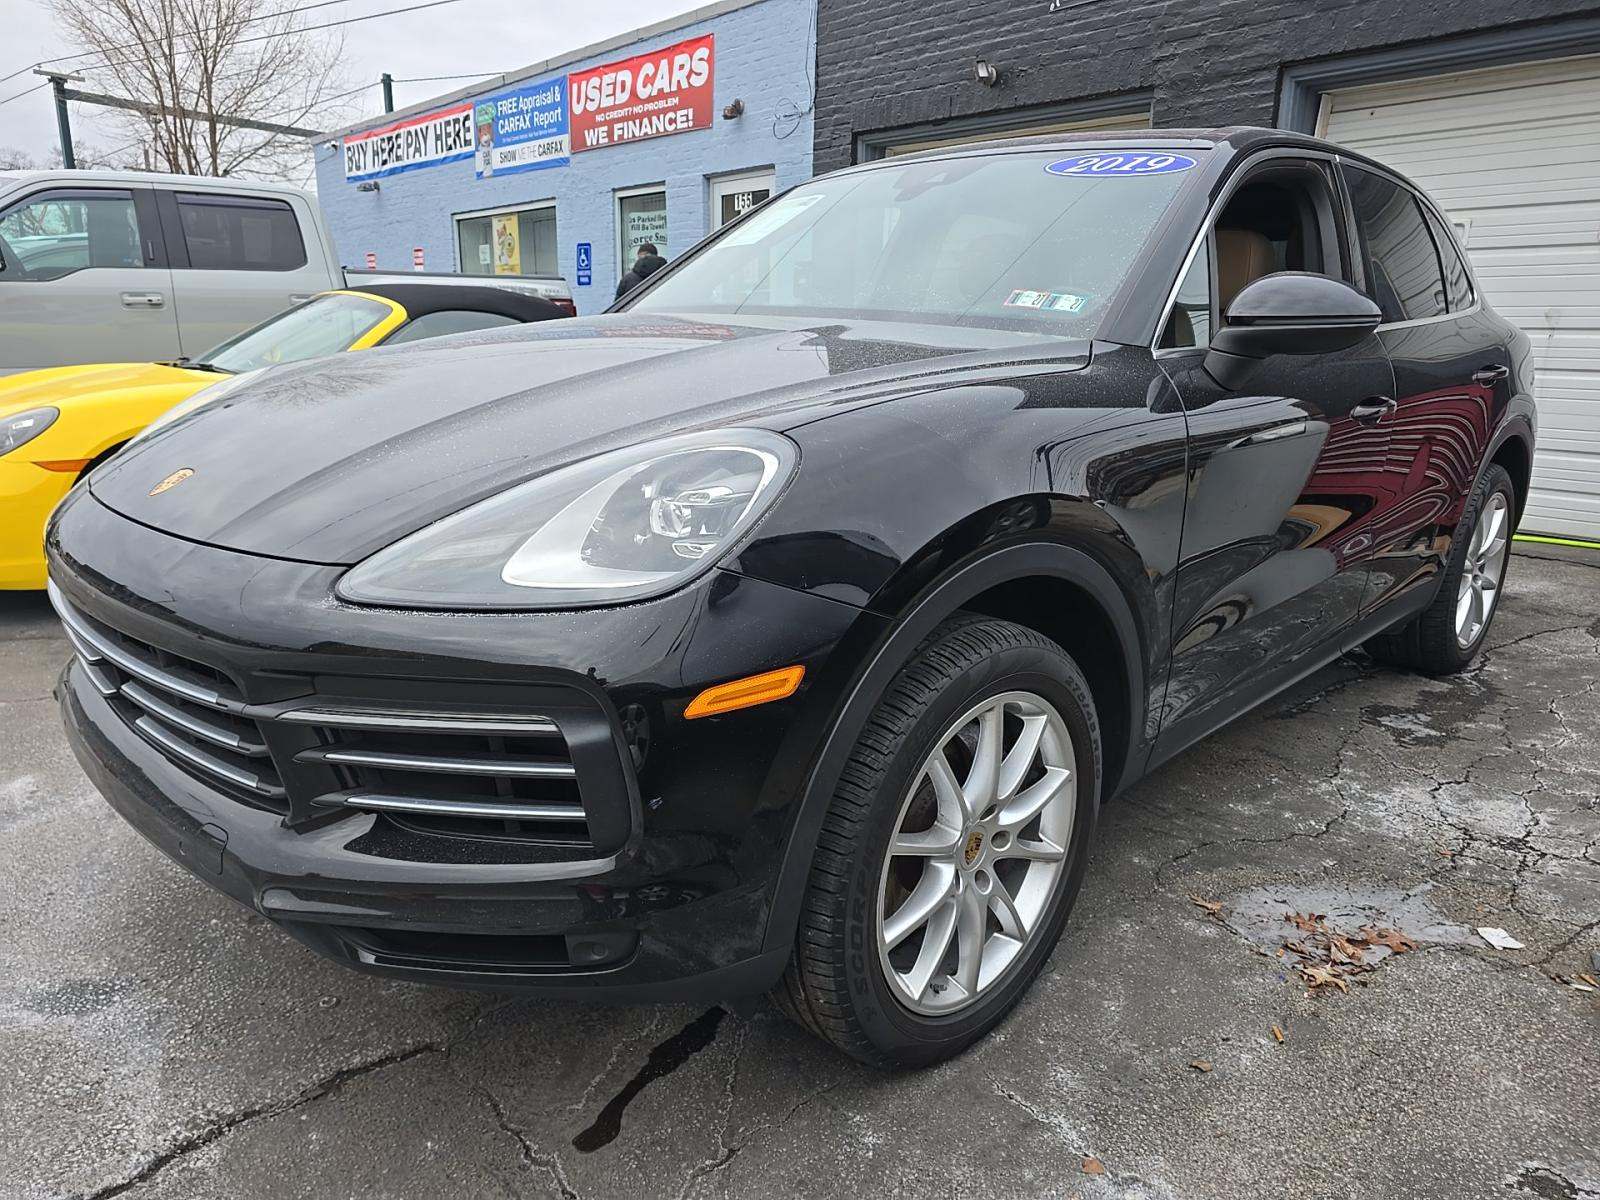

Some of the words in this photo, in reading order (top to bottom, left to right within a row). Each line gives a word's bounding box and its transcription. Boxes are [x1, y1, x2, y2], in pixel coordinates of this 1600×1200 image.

[571, 69, 633, 115] USED
[636, 46, 710, 100] CARS
[497, 97, 518, 117] FREE
[519, 86, 554, 114] Appraisal
[554, 85, 561, 102] &
[595, 114, 605, 123] NO
[605, 107, 633, 120] CREDIT?
[633, 105, 644, 115] NO
[644, 96, 680, 112] PROBLEM
[498, 113, 531, 135] CARFAX
[533, 107, 562, 128] Report
[584, 126, 609, 147] WE
[613, 108, 694, 142] FINANCE!
[345, 141, 368, 173] BUY
[433, 113, 472, 155] HERE
[499, 148, 517, 164] SHOW
[537, 139, 564, 157] CARFAX
[1063, 156, 1177, 173] 2019
[736, 192, 751, 209] 155
